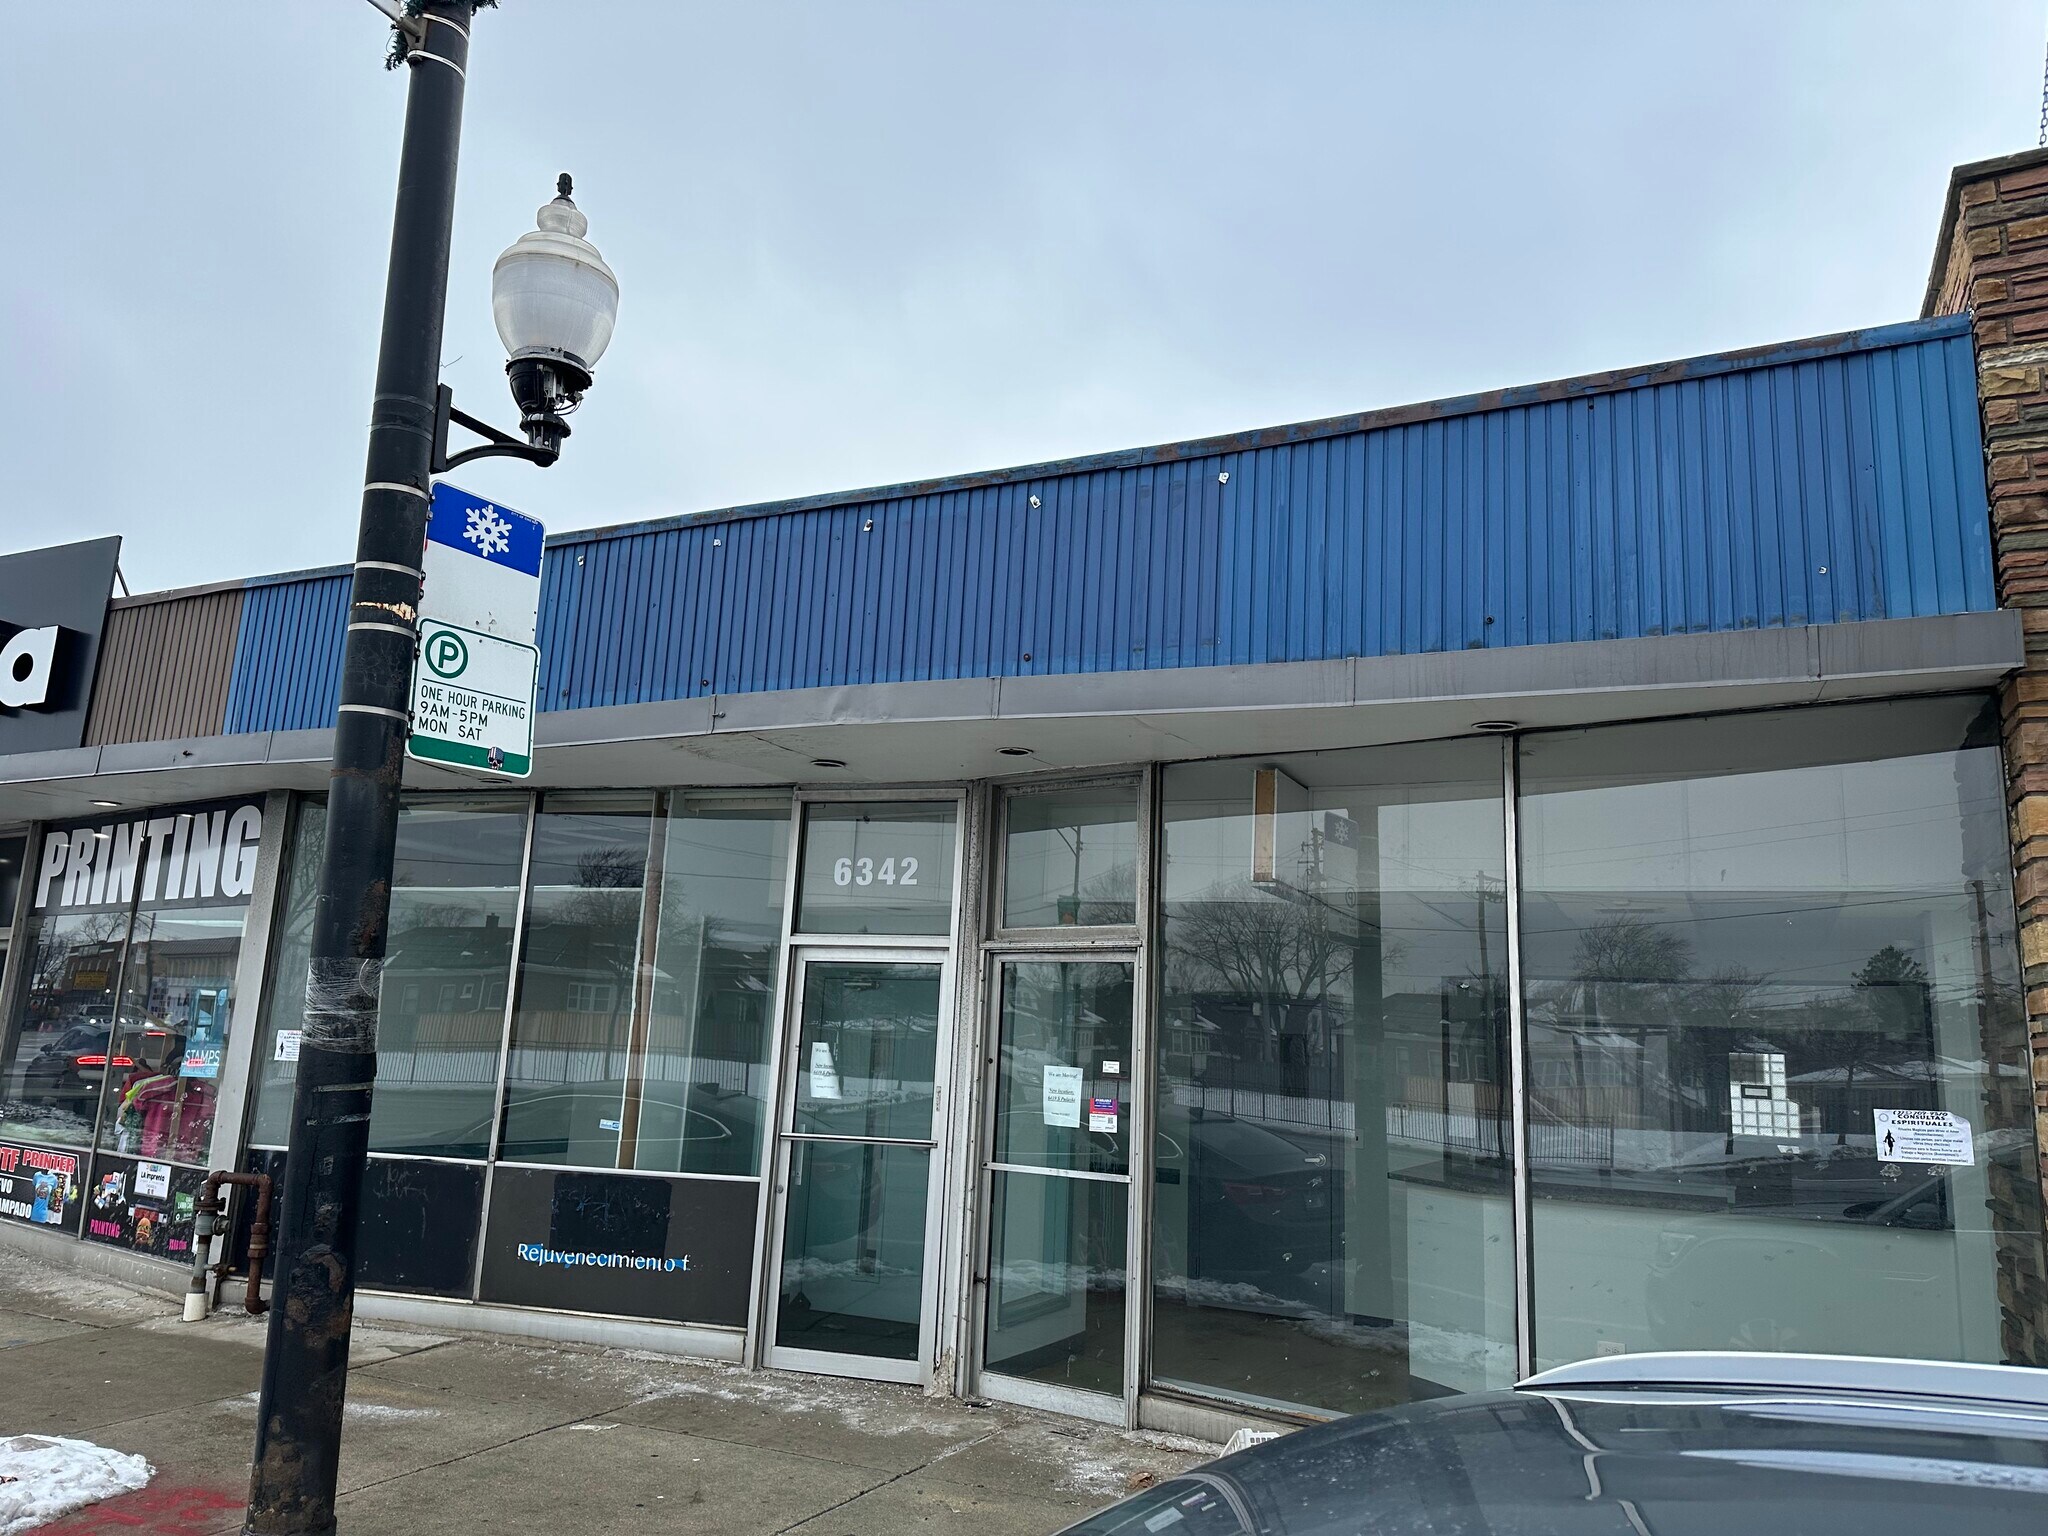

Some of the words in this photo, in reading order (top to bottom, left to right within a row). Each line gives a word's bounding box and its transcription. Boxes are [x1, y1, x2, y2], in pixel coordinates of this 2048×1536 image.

[420, 701, 488, 727] 9AM-5PM
[421, 685, 443, 702] ONE
[448, 691, 478, 709] HOUR
[482, 699, 526, 720] PARKING
[418, 716, 448, 734] MON
[458, 725, 482, 741] SAT
[35, 805, 262, 908] PRINTING
[834, 857, 919, 886] 6342
[185, 1049, 220, 1064] STAMPS
[0, 1147, 20, 1172] TF
[22, 1149, 76, 1175] PRINTER
[0, 1177, 13, 1194] VO
[0, 1197, 32, 1219] MPADO
[90, 1219, 120, 1238] PRINTING
